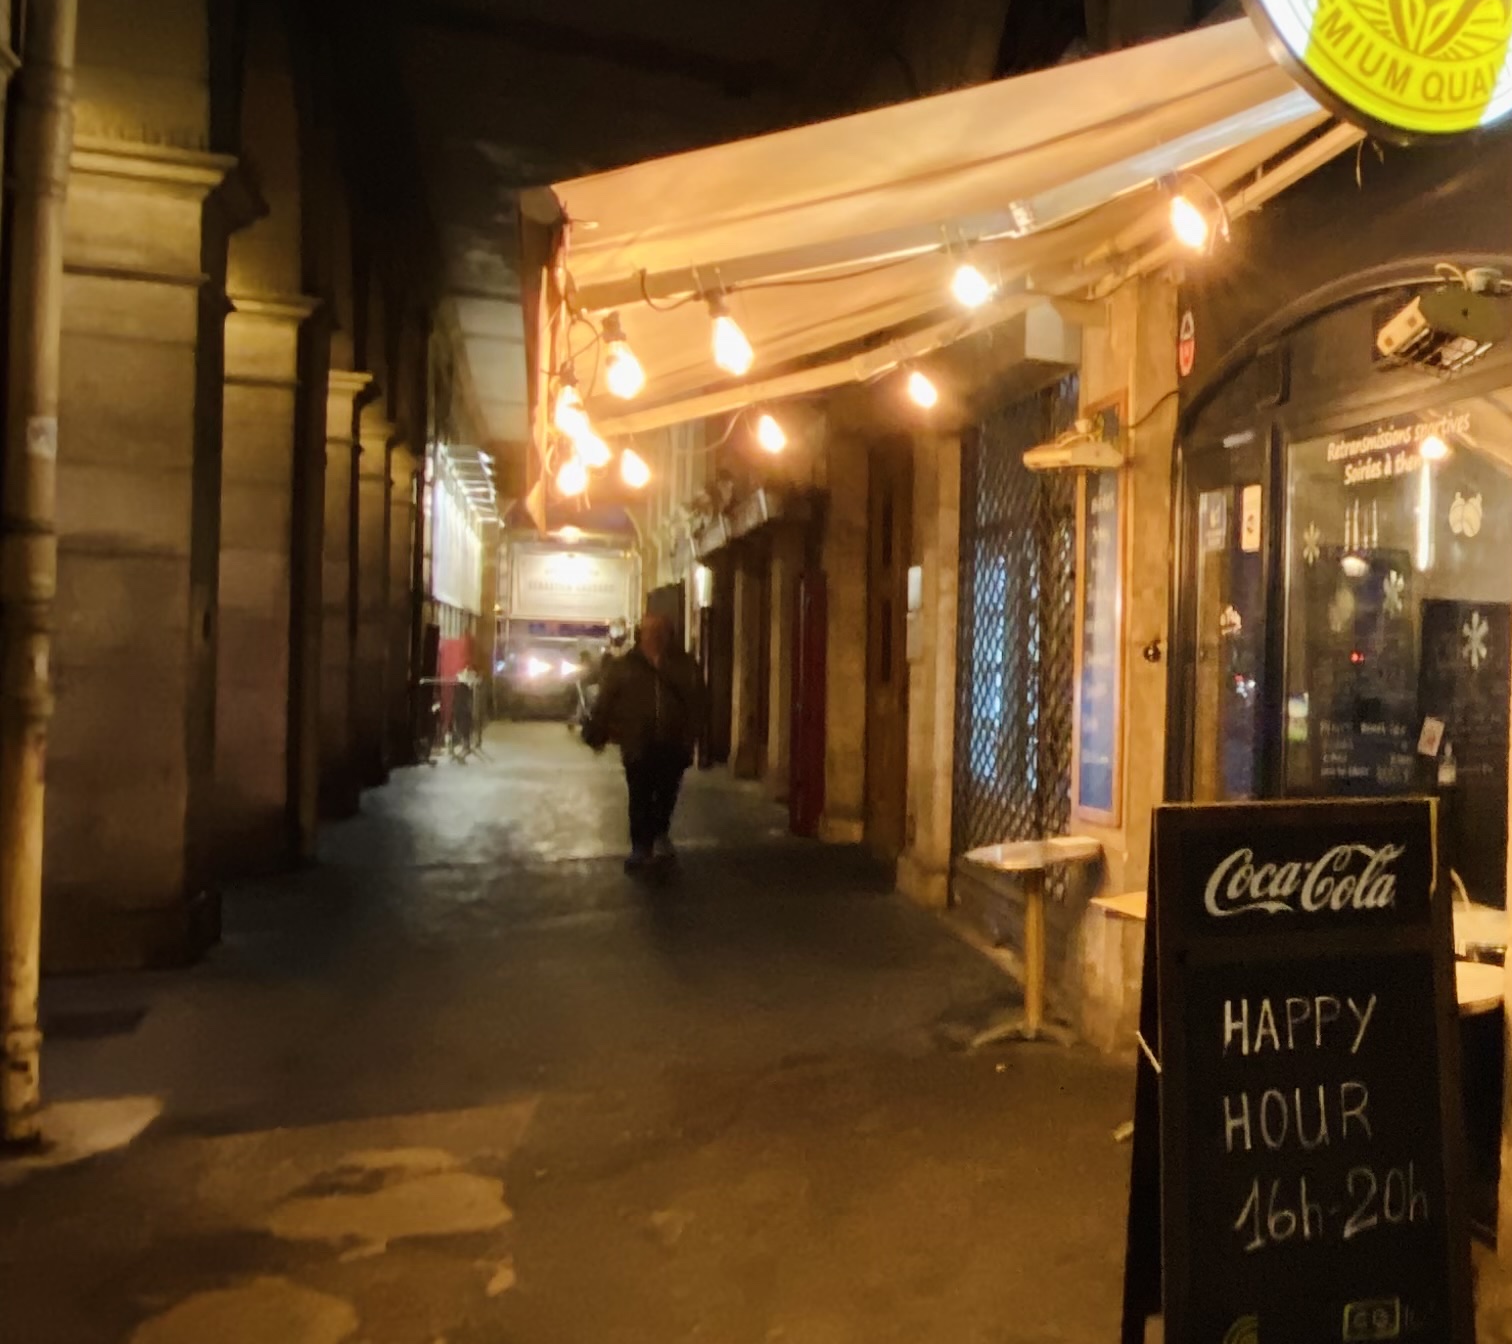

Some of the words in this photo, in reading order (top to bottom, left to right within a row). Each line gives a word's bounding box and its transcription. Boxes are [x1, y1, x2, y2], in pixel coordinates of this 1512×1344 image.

[1204, 843, 1406, 916] Coca-Cola
[1223, 993, 1377, 1056] HAPPY
[1223, 1081, 1373, 1154] HOUR
